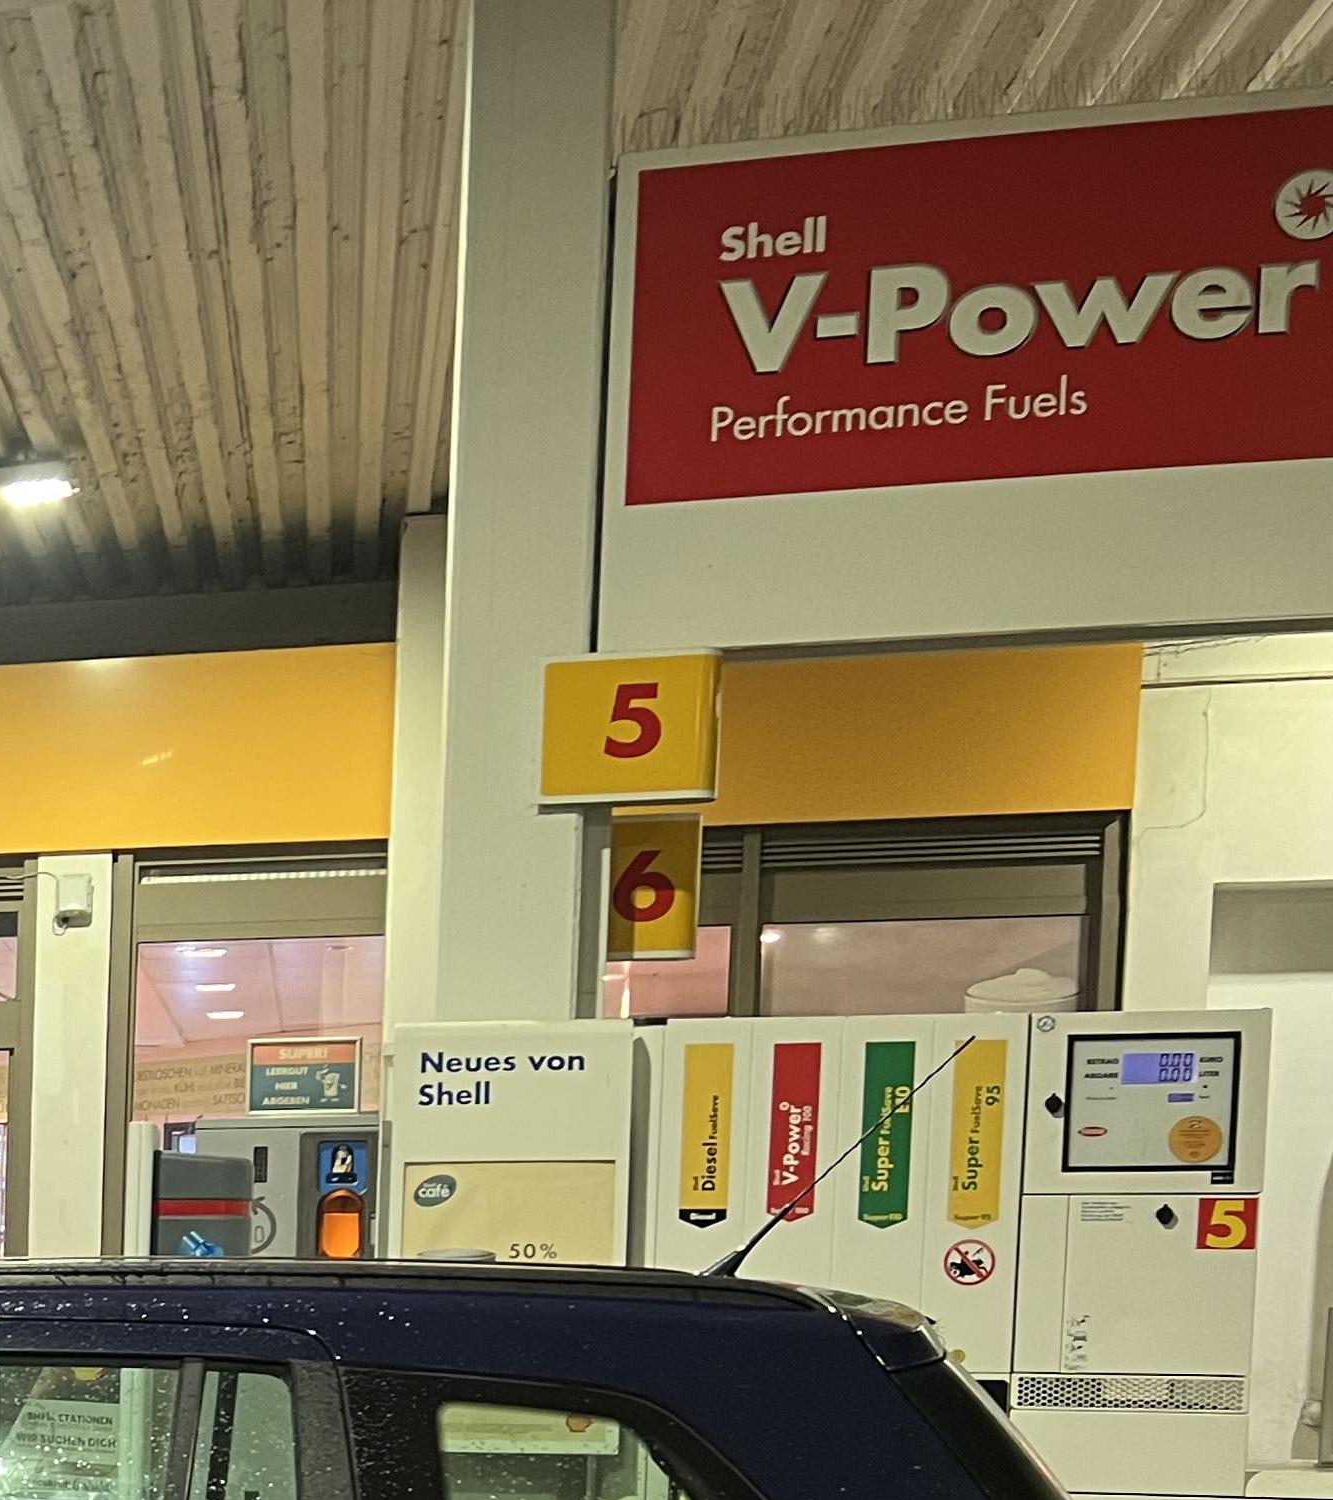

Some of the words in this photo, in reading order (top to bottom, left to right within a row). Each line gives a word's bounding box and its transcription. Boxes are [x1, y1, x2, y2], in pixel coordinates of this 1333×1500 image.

[719, 216, 827, 262] Shell
[719, 260, 1321, 375] V-Power
[711, 396, 968, 443] Performance
[983, 375, 1088, 422] Fuels
[603, 682, 663, 759] 5
[612, 850, 676, 922] 6
[265, 1066, 309, 1077] LEERGUT
[420, 1051, 517, 1073] Neues
[527, 1054, 586, 1071] von
[262, 1096, 311, 1106] ABGEBEN
[275, 1082, 299, 1091] HIER
[418, 1080, 491, 1106] Shell
[985, 1085, 1001, 1106] 95
[709, 1095, 720, 1140] FuelSave
[701, 1140, 718, 1192] Diesel
[781, 1104, 803, 1186] V-Power
[871, 1137, 894, 1192] Super
[961, 1136, 984, 1191] Super
[417, 1183, 451, 1199] café
[1205, 1200, 1248, 1249] 5
[508, 1242, 558, 1260] 50%
[15, 1432, 38, 1442] WIR
[39, 1433, 86, 1446] SUCHEN
[87, 1437, 118, 1449] DICH
